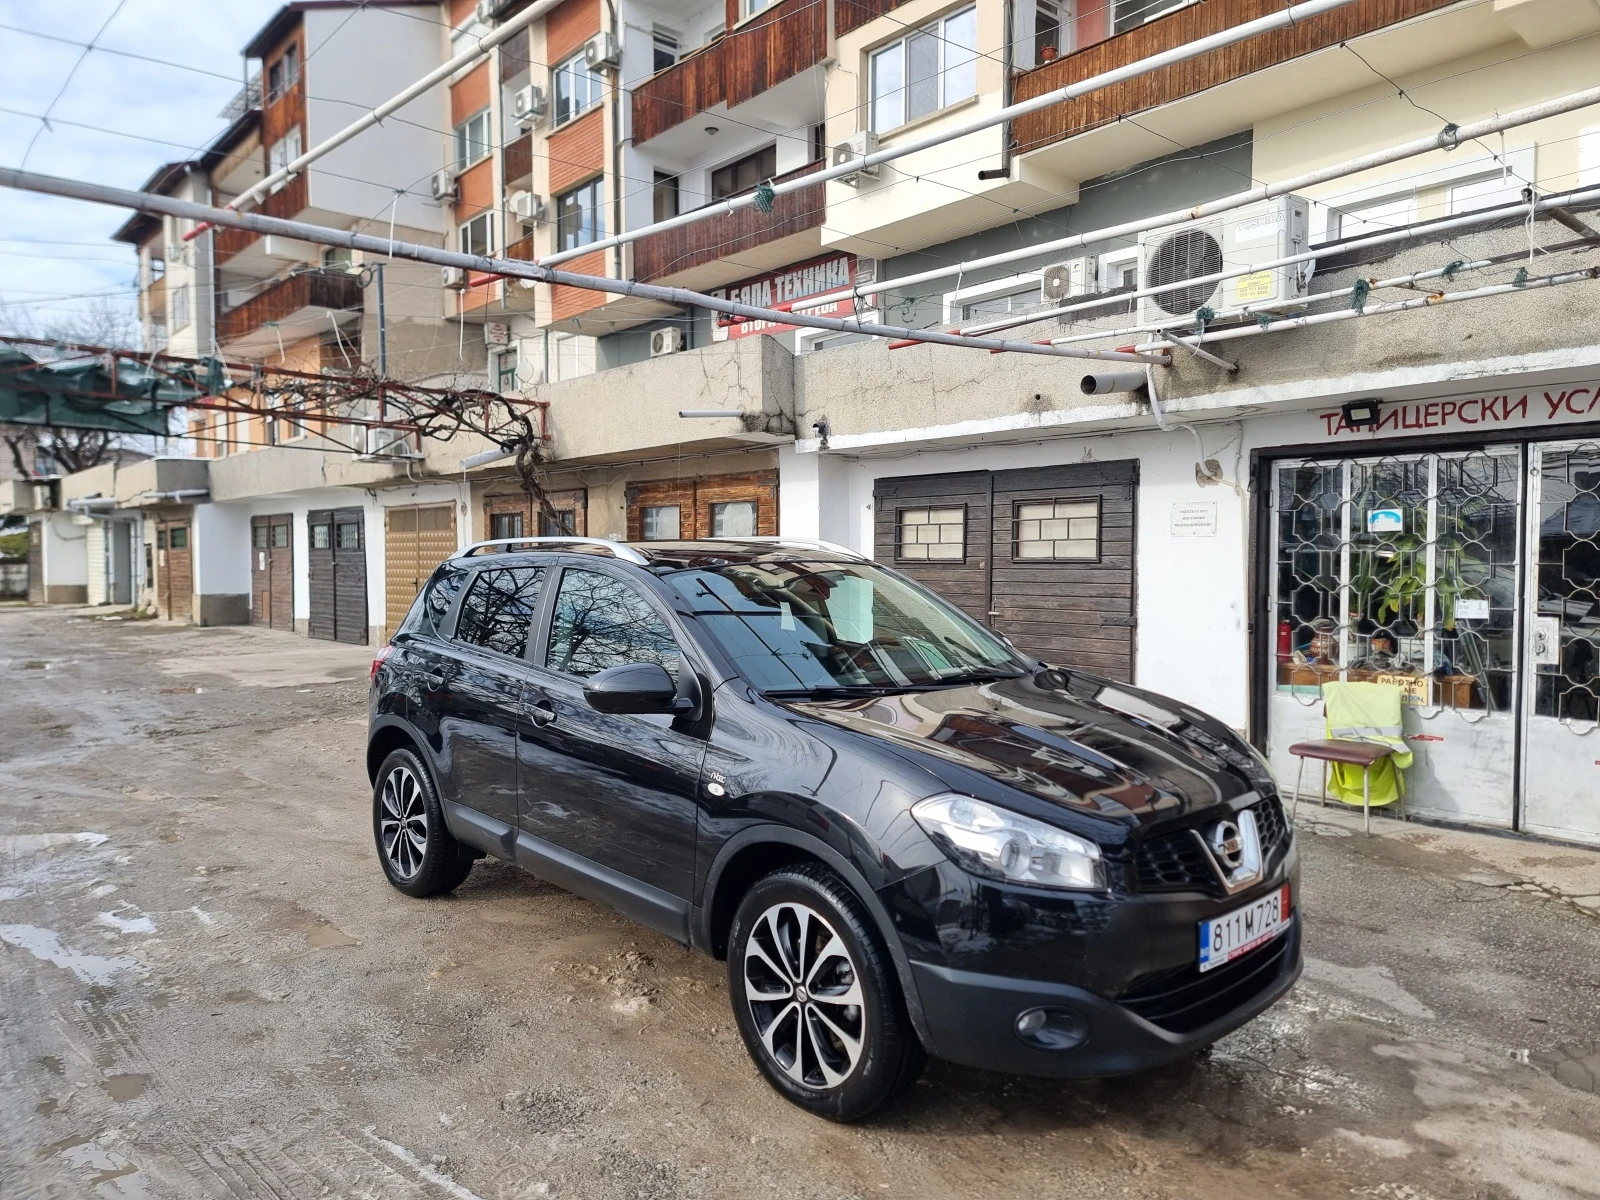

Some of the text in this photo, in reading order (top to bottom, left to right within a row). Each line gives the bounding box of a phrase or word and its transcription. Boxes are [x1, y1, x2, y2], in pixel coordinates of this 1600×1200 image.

[1236, 212, 1286, 231] TOSHIBA
[774, 257, 850, 304] ТЕХНИКА
[1319, 395, 1528, 436] ТАИЦЕРСКИ
